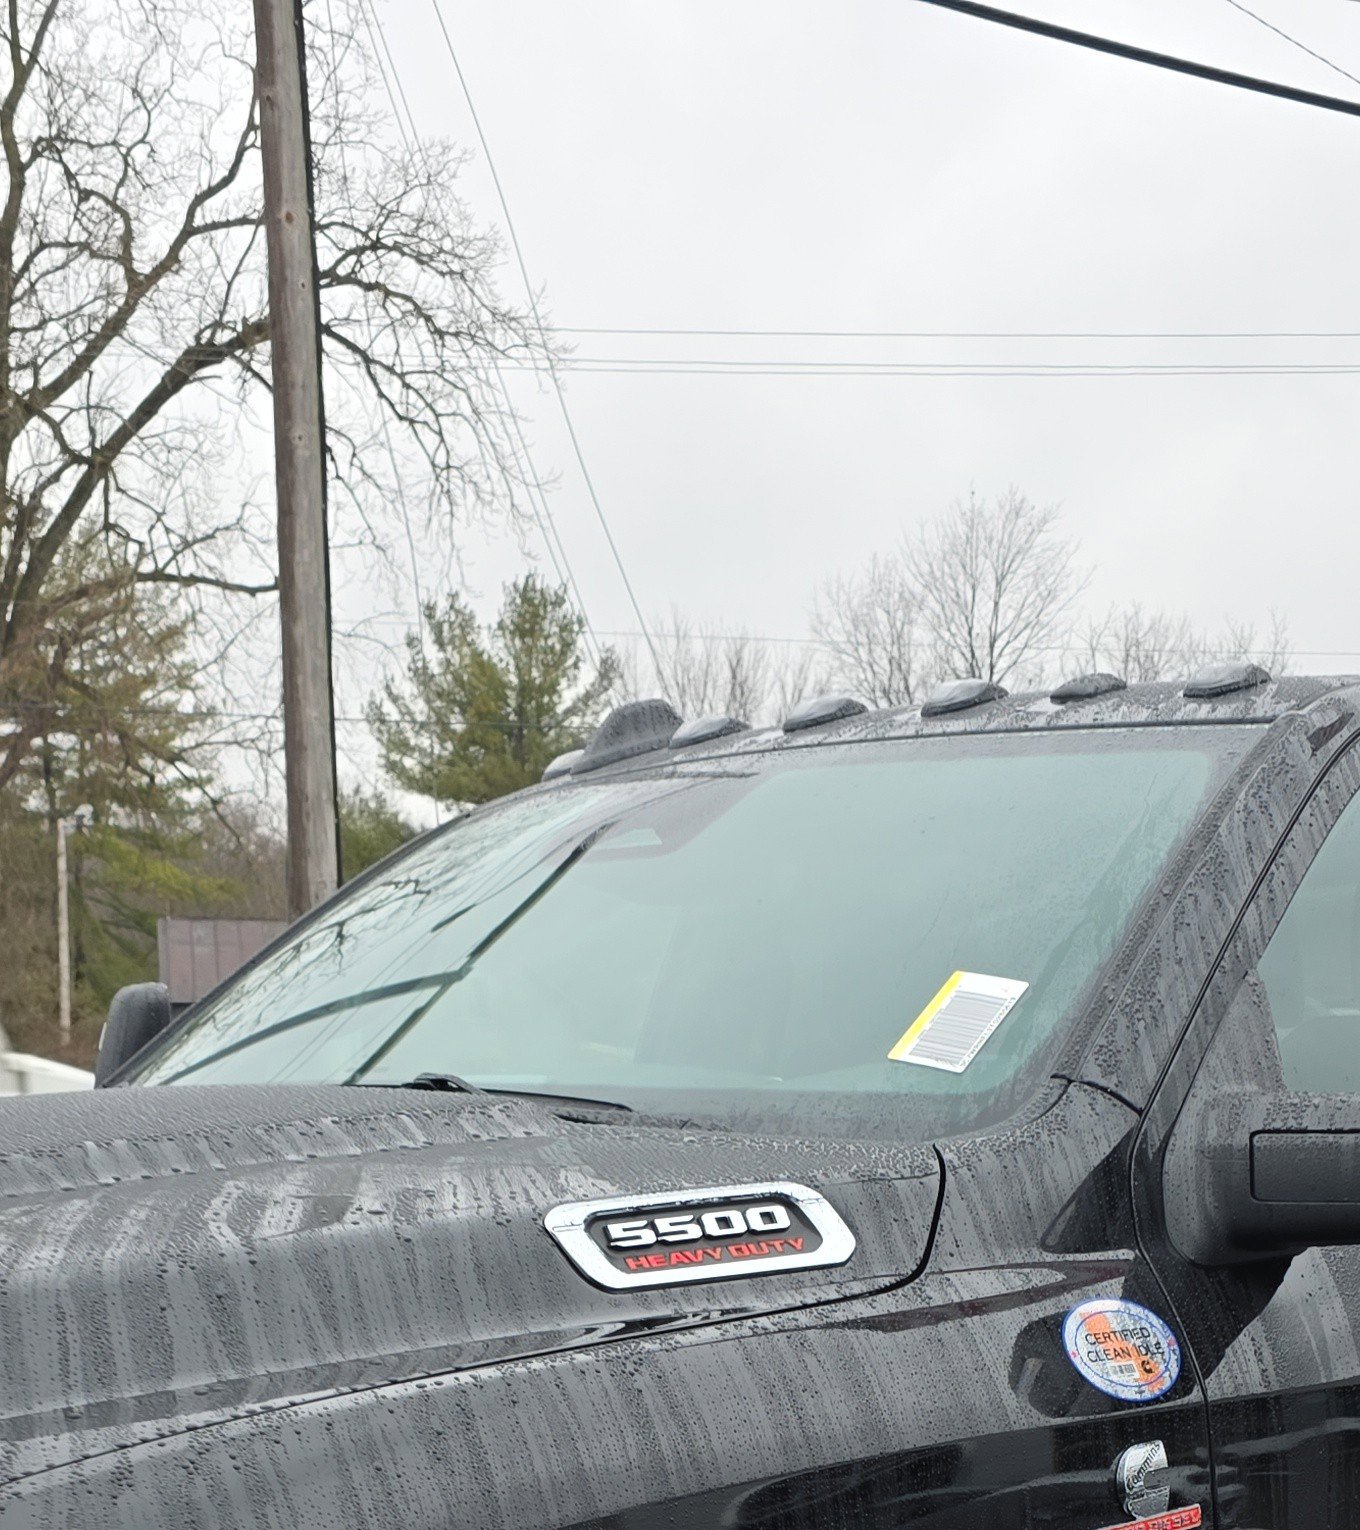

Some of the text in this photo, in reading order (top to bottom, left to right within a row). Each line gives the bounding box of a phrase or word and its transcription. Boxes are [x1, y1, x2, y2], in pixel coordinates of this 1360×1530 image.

[605, 1204, 791, 1249] 5500
[624, 1236, 805, 1272] HEAVY DUTY
[1085, 1326, 1151, 1345] CERTIFIED
[1087, 1341, 1165, 1363] CLEAN IDLE
[1126, 1442, 1161, 1491] Cummins
